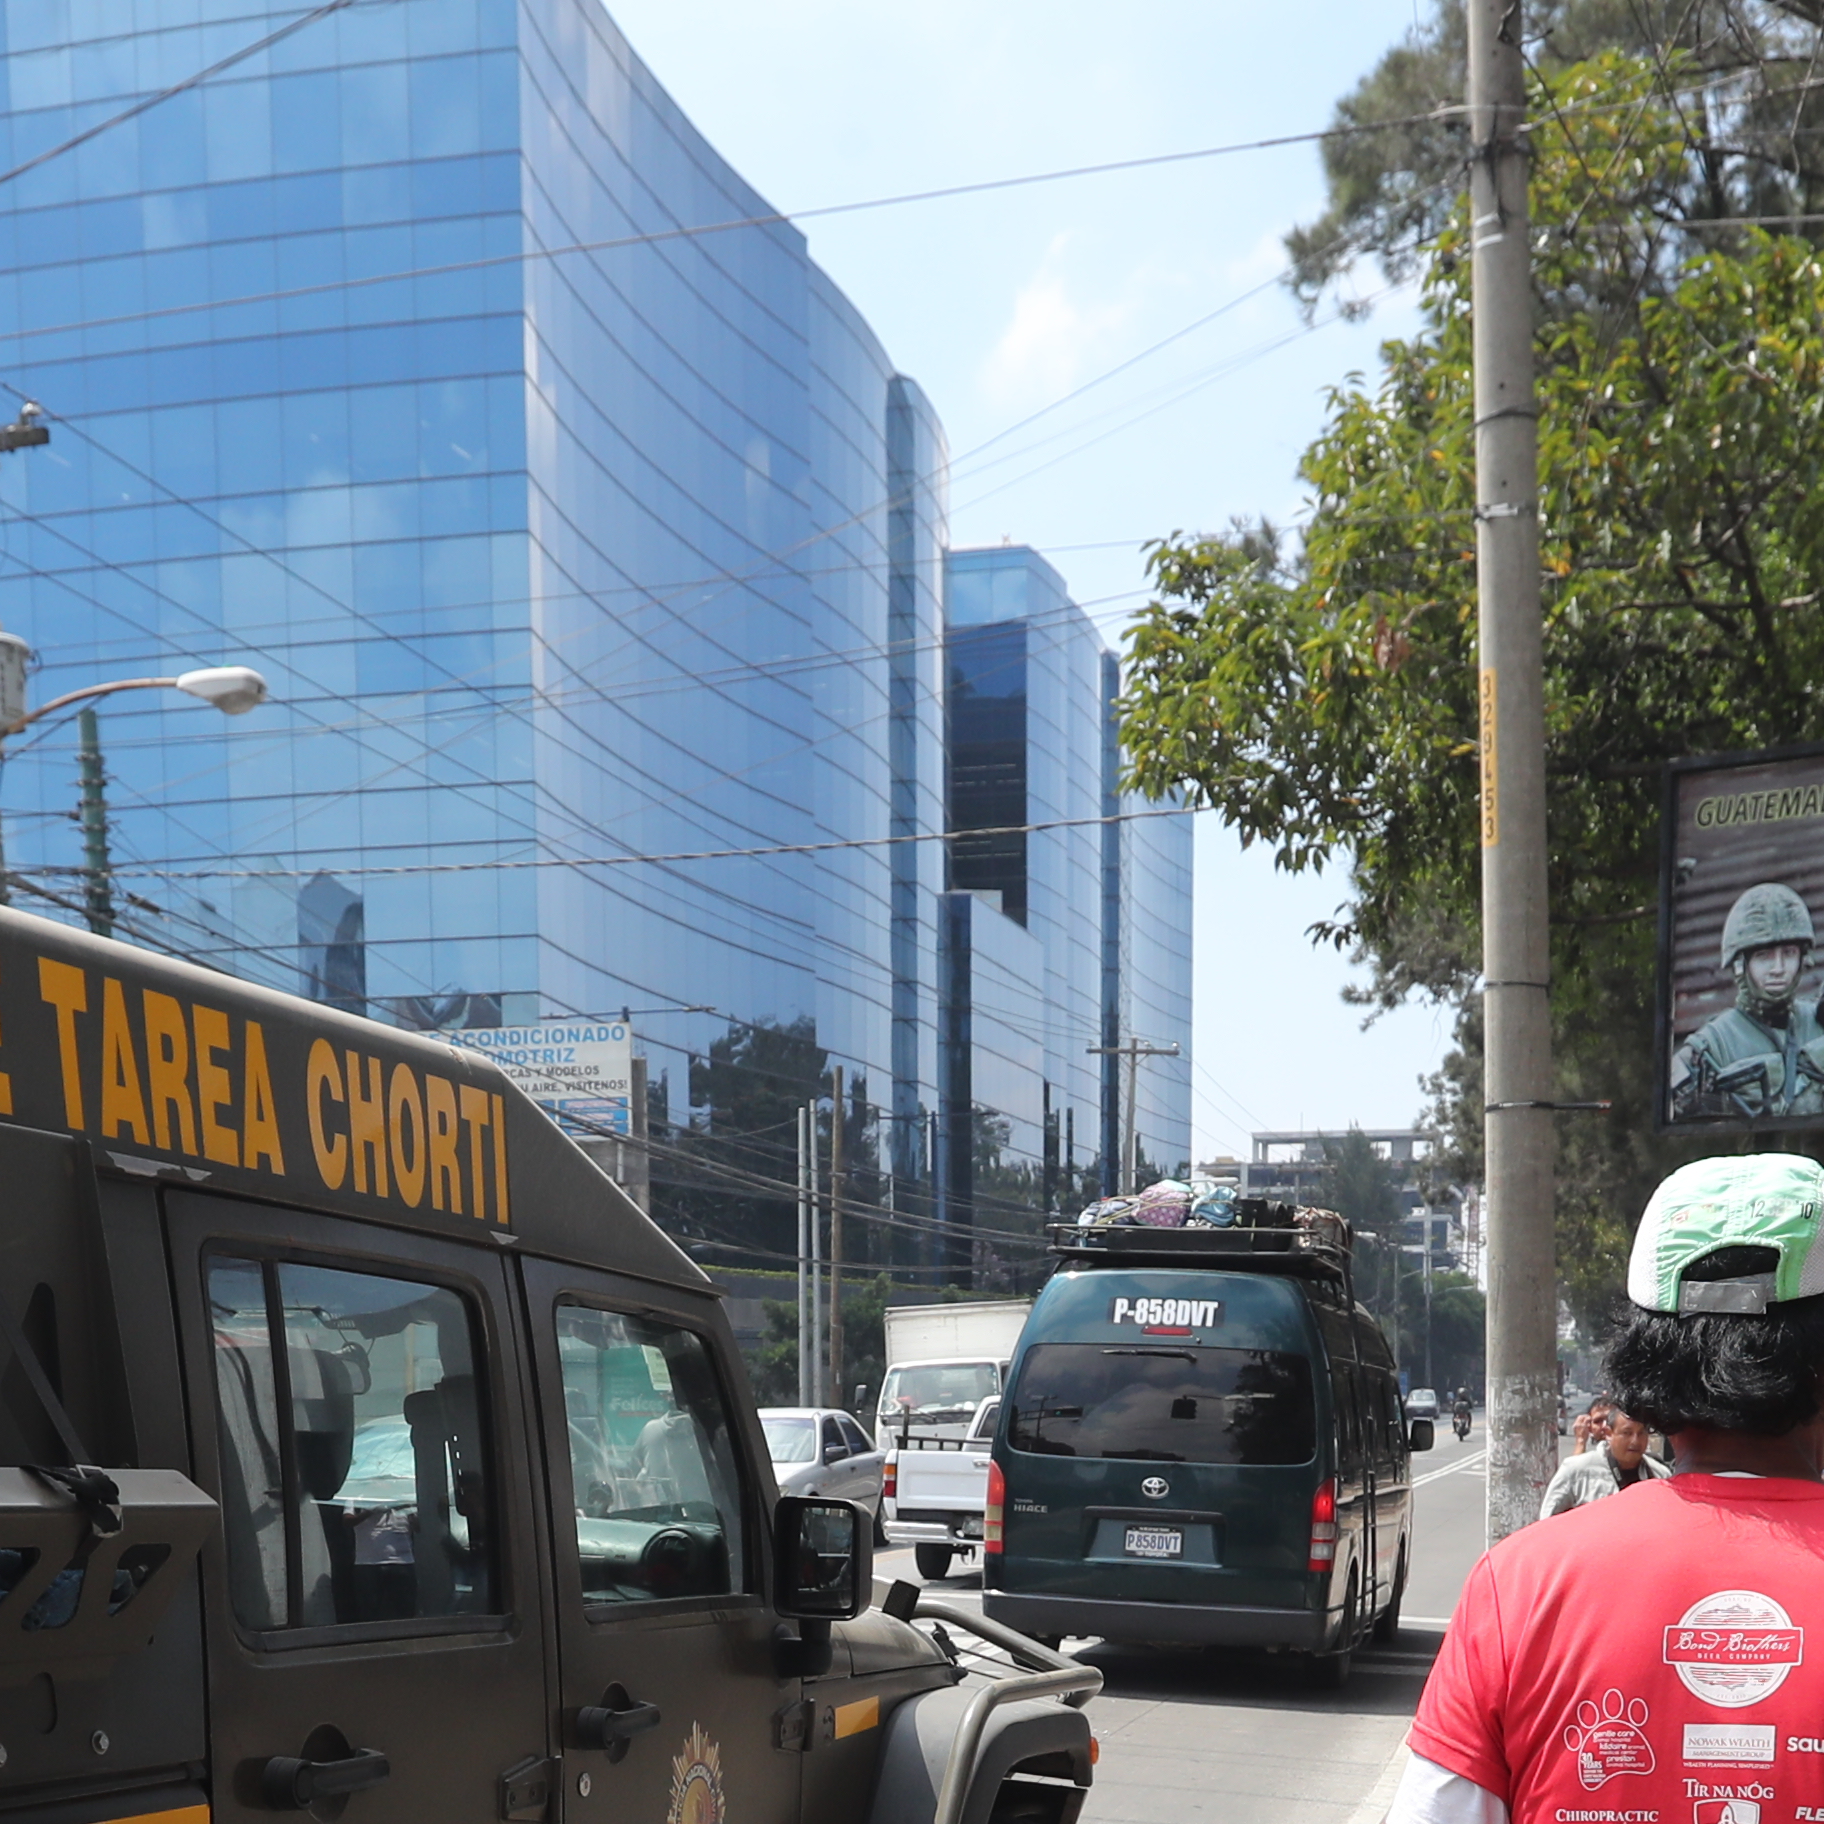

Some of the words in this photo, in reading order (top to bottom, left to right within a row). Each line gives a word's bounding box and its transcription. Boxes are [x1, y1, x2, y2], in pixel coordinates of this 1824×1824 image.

[449, 1025, 625, 1048] ACONDICIONADO
[536, 1067, 543, 1077] Y
[546, 1065, 600, 1077] MODELOS
[37, 956, 285, 1176] TAREA
[307, 1037, 509, 1225] CHORTI
[531, 1081, 562, 1093] AIRE,
[565, 1079, 627, 1092] VISITENOS!
[1113, 1298, 1219, 1327] P-858DVT
[1013, 1503, 1048, 1514] HIACE
[1127, 1533, 1180, 1551] P858DVT
[1673, 1631, 1727, 1650] Bond
[1723, 1632, 1796, 1652] Brothers
[1688, 1737, 1727, 1747] NOWAK
[1728, 1738, 1771, 1748] WEALTH
[1712, 1785, 1734, 1797] NA
[1555, 1808, 1659, 1822] CHIROPRACTIC
